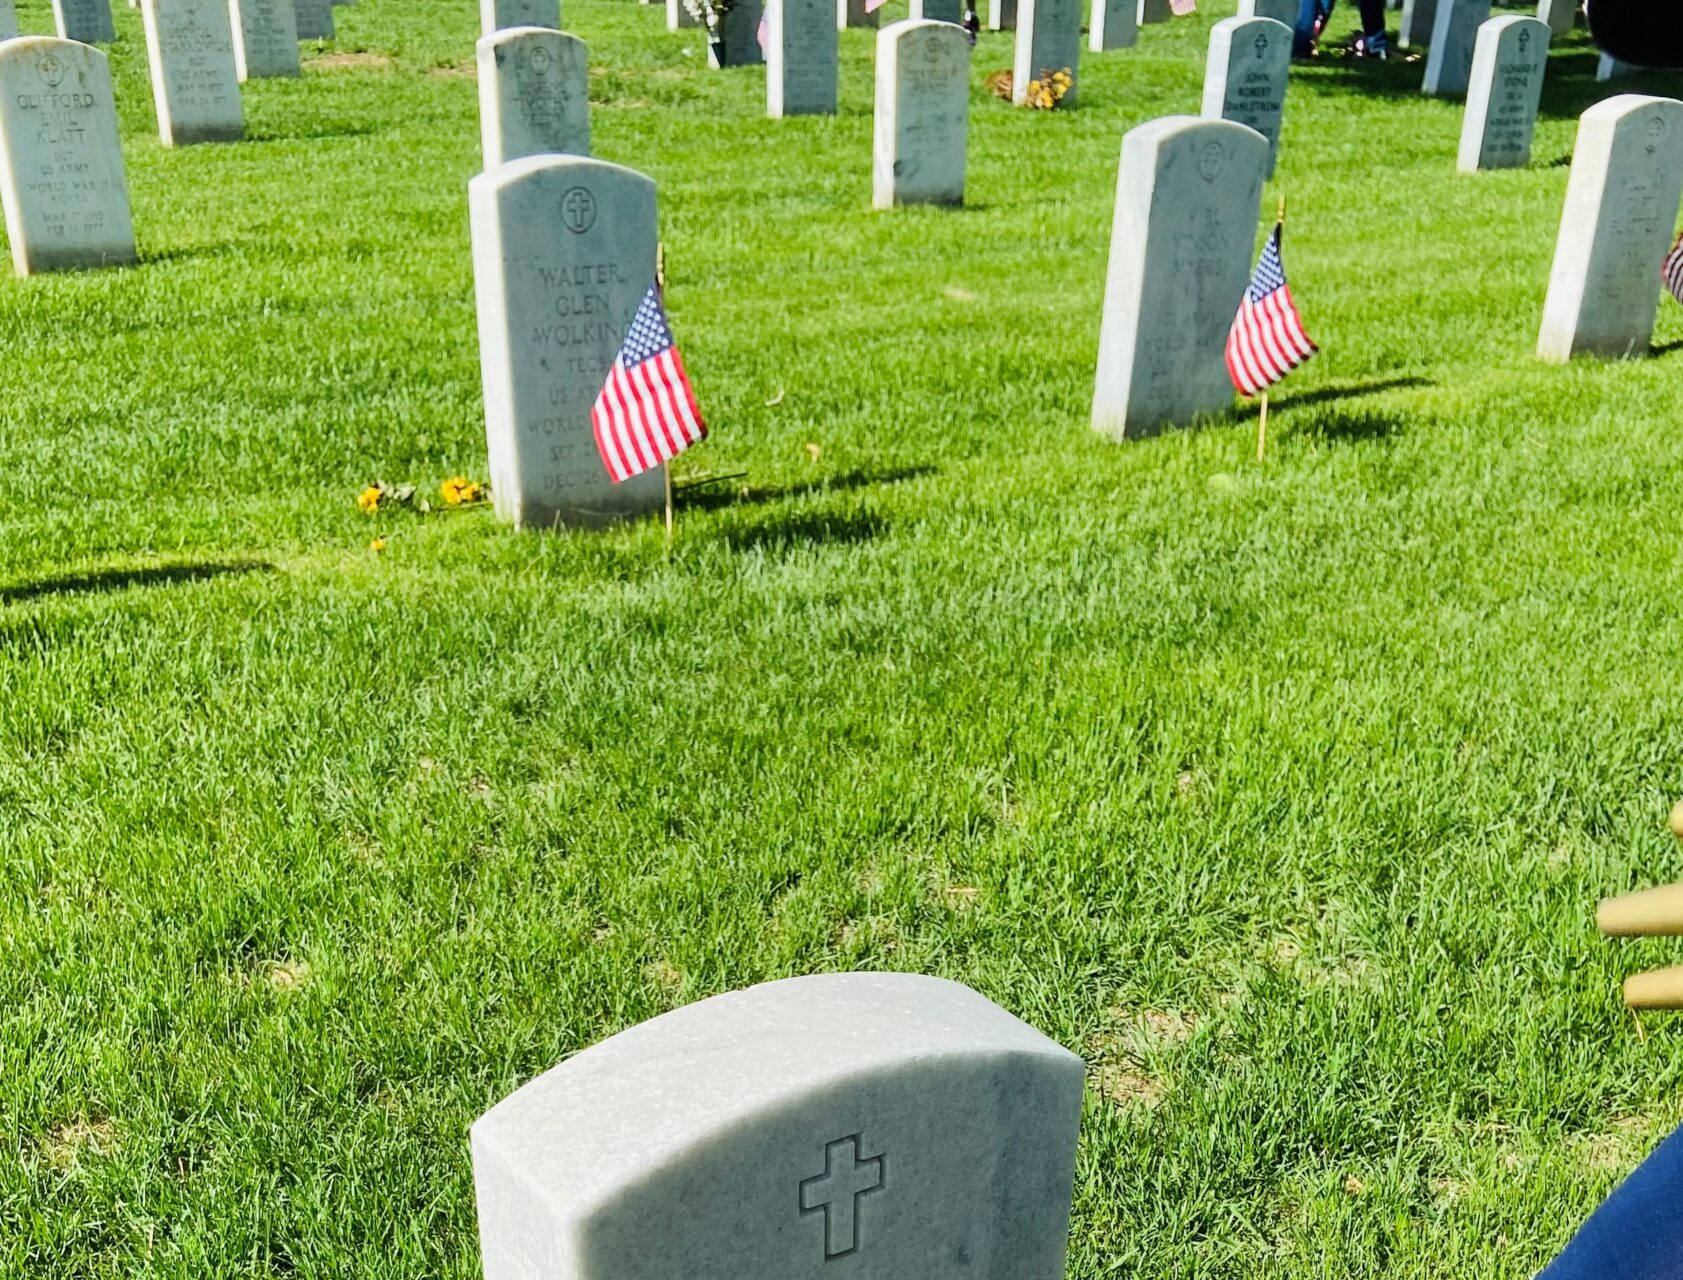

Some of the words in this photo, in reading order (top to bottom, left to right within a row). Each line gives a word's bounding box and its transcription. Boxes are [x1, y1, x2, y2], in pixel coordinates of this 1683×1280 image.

[16, 92, 97, 110] CLIFFORD
[40, 110, 79, 127] EMIL
[37, 127, 86, 144] KLATT
[40, 163, 54, 176] US
[539, 263, 627, 288] WALTER
[555, 293, 612, 317] GLEN
[527, 417, 587, 435] WORLD
[543, 471, 576, 490] DEC
